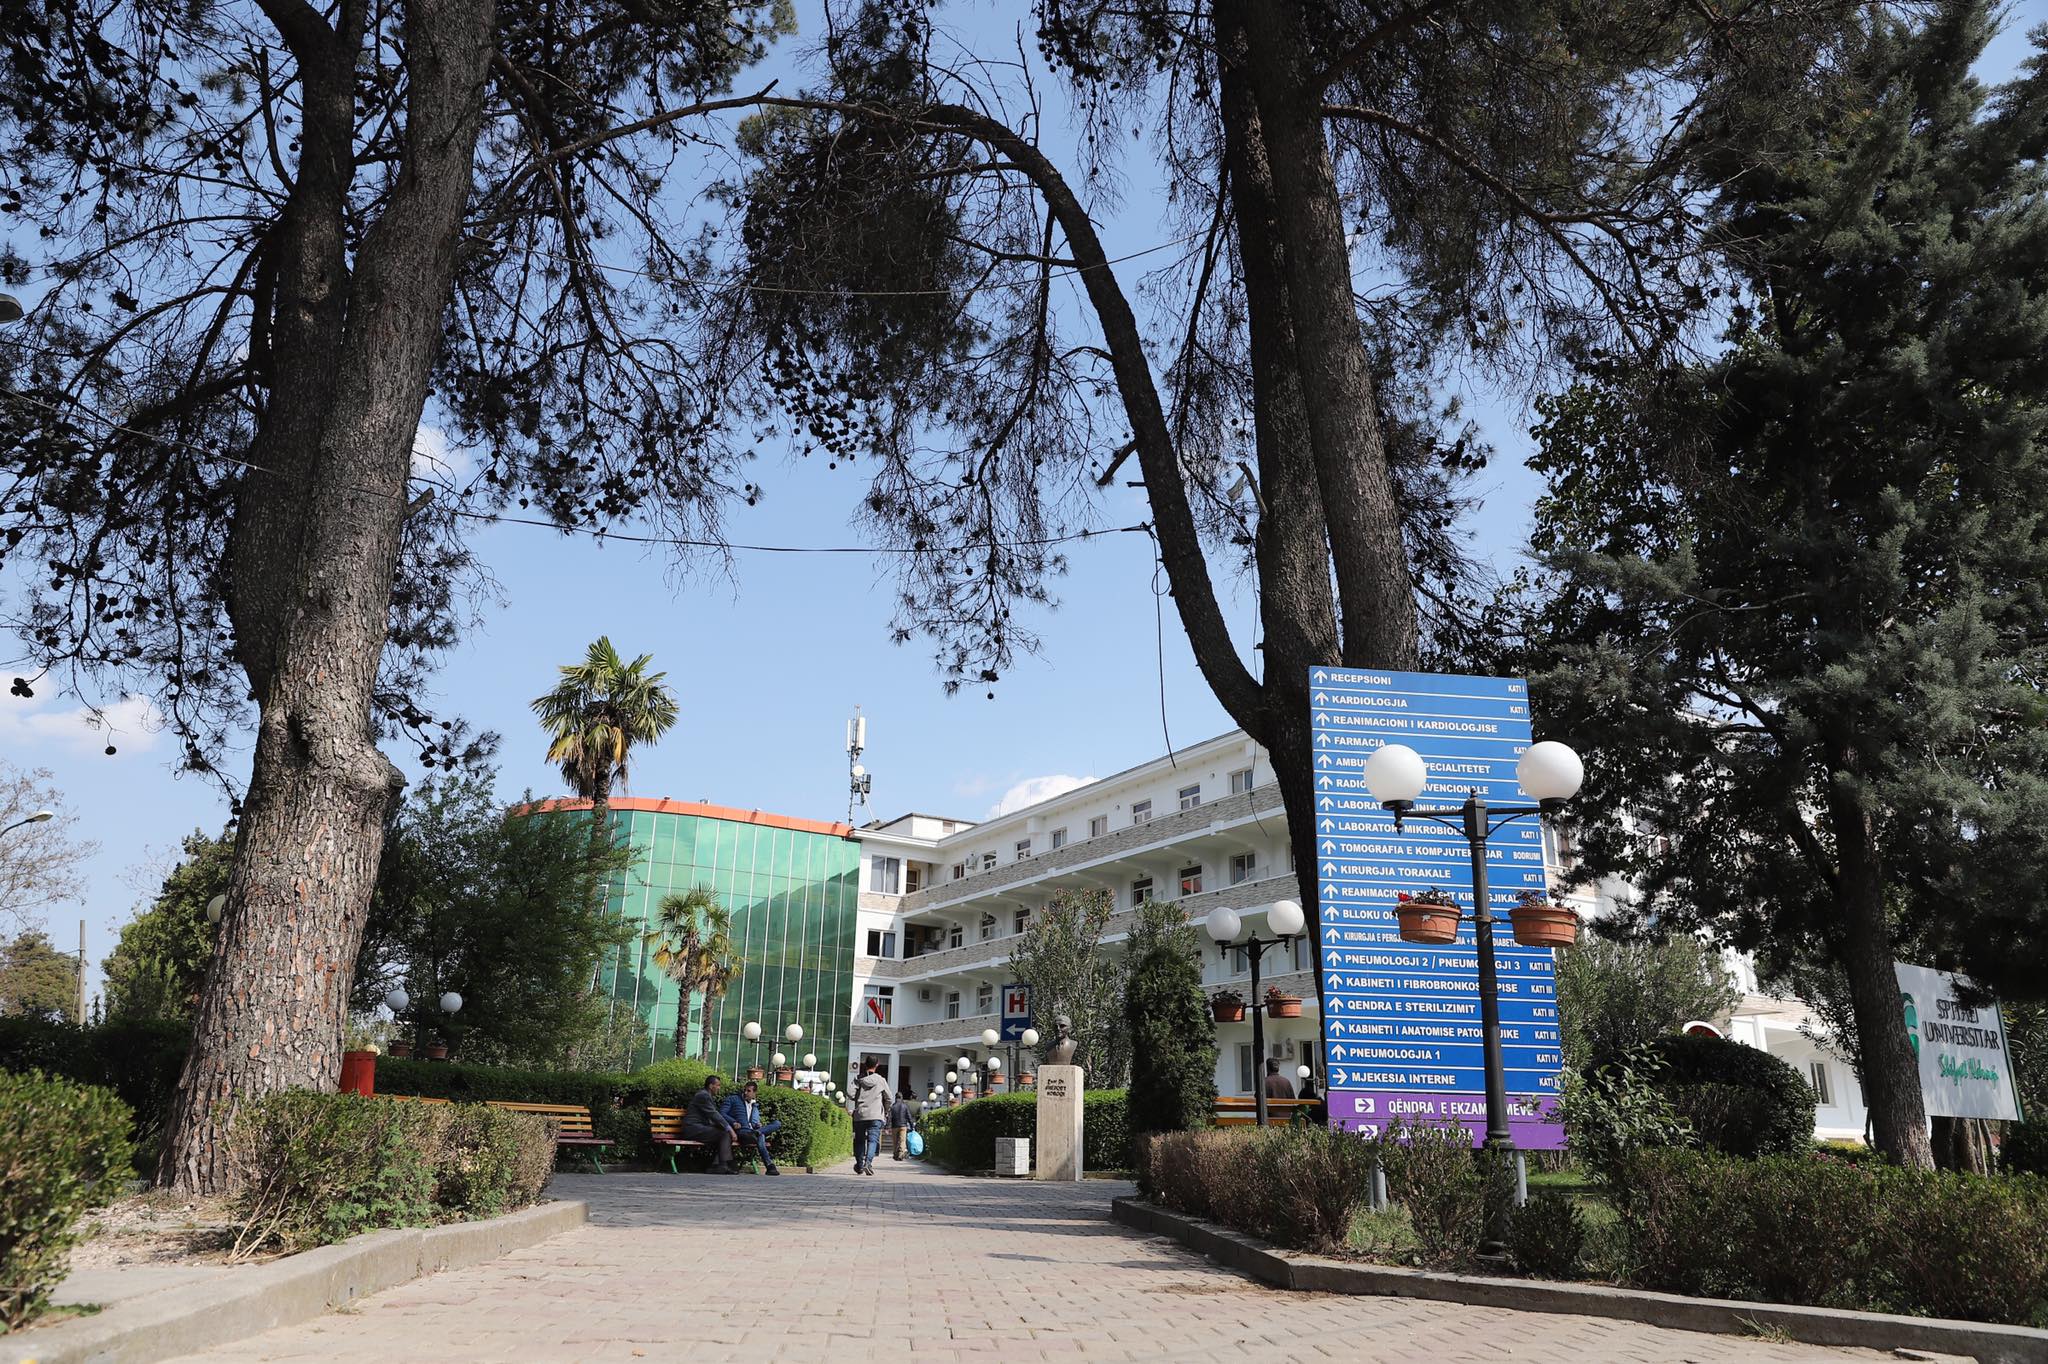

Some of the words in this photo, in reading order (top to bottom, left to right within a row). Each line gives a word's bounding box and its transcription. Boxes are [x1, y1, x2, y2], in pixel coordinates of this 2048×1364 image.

[1331, 673, 1392, 685] RECEPSIONI
[1508, 684, 1521, 693] KATI
[1332, 695, 1408, 707] KARDIOLOGJIA
[1510, 705, 1523, 714] KATI
[1333, 715, 1408, 728] REANIMACIONI
[1411, 720, 1414, 728] I
[1417, 720, 1498, 733] KARDIOLOGJISE
[1334, 736, 1386, 747] FARMACIA
[1424, 762, 1491, 774] PECIALITETET
[1338, 822, 1398, 833] LABORATOR
[1521, 830, 1535, 839] KATI
[1340, 843, 1404, 855] TOMOGRAFIA
[1406, 846, 1413, 855] E
[1340, 865, 1395, 876] KIRURGJIA
[1398, 867, 1451, 878] TORAKALE
[1523, 873, 1537, 882] KATI
[1343, 910, 1380, 920] BLLOKU
[1344, 931, 1375, 942] KIRURGJIA
[1377, 934, 1381, 942] E
[1345, 954, 1419, 966] PNEUMOLOGJI
[1422, 957, 1428, 967] 2
[1431, 955, 1436, 969] /
[1514, 961, 1521, 970] 3
[1529, 962, 1544, 971] KATI
[1346, 977, 1394, 988] KABINETI
[1397, 979, 1401, 988] I
[1531, 985, 1545, 993] KATI
[1008, 993, 1025, 1013] H
[1347, 1000, 1392, 1011] QENDRA
[1395, 1002, 1402, 1011] E
[1405, 1002, 1476, 1014] STERILIZIMIT
[1532, 1008, 1547, 1017] KATI
[1348, 1024, 1393, 1035] KABINETI
[1395, 1026, 1399, 1035] I
[1401, 1026, 1455, 1037] ANATOMISE
[1535, 1031, 1549, 1040] KATI
[1922, 1020, 2000, 1050] UNIVERSITAR
[1350, 1048, 1433, 1060] PNEUMOLOGJIA
[1435, 1050, 1441, 1060] 1
[1536, 1054, 1550, 1063] KATI
[1551, 1054, 1559, 1063] IV
[1352, 1072, 1406, 1083] MJEKESIA
[1409, 1074, 1456, 1085] INTERNE
[1539, 1078, 1553, 1087] KATI
[1388, 1098, 1435, 1114] QËNDRA
[1440, 1102, 1448, 1114] E
